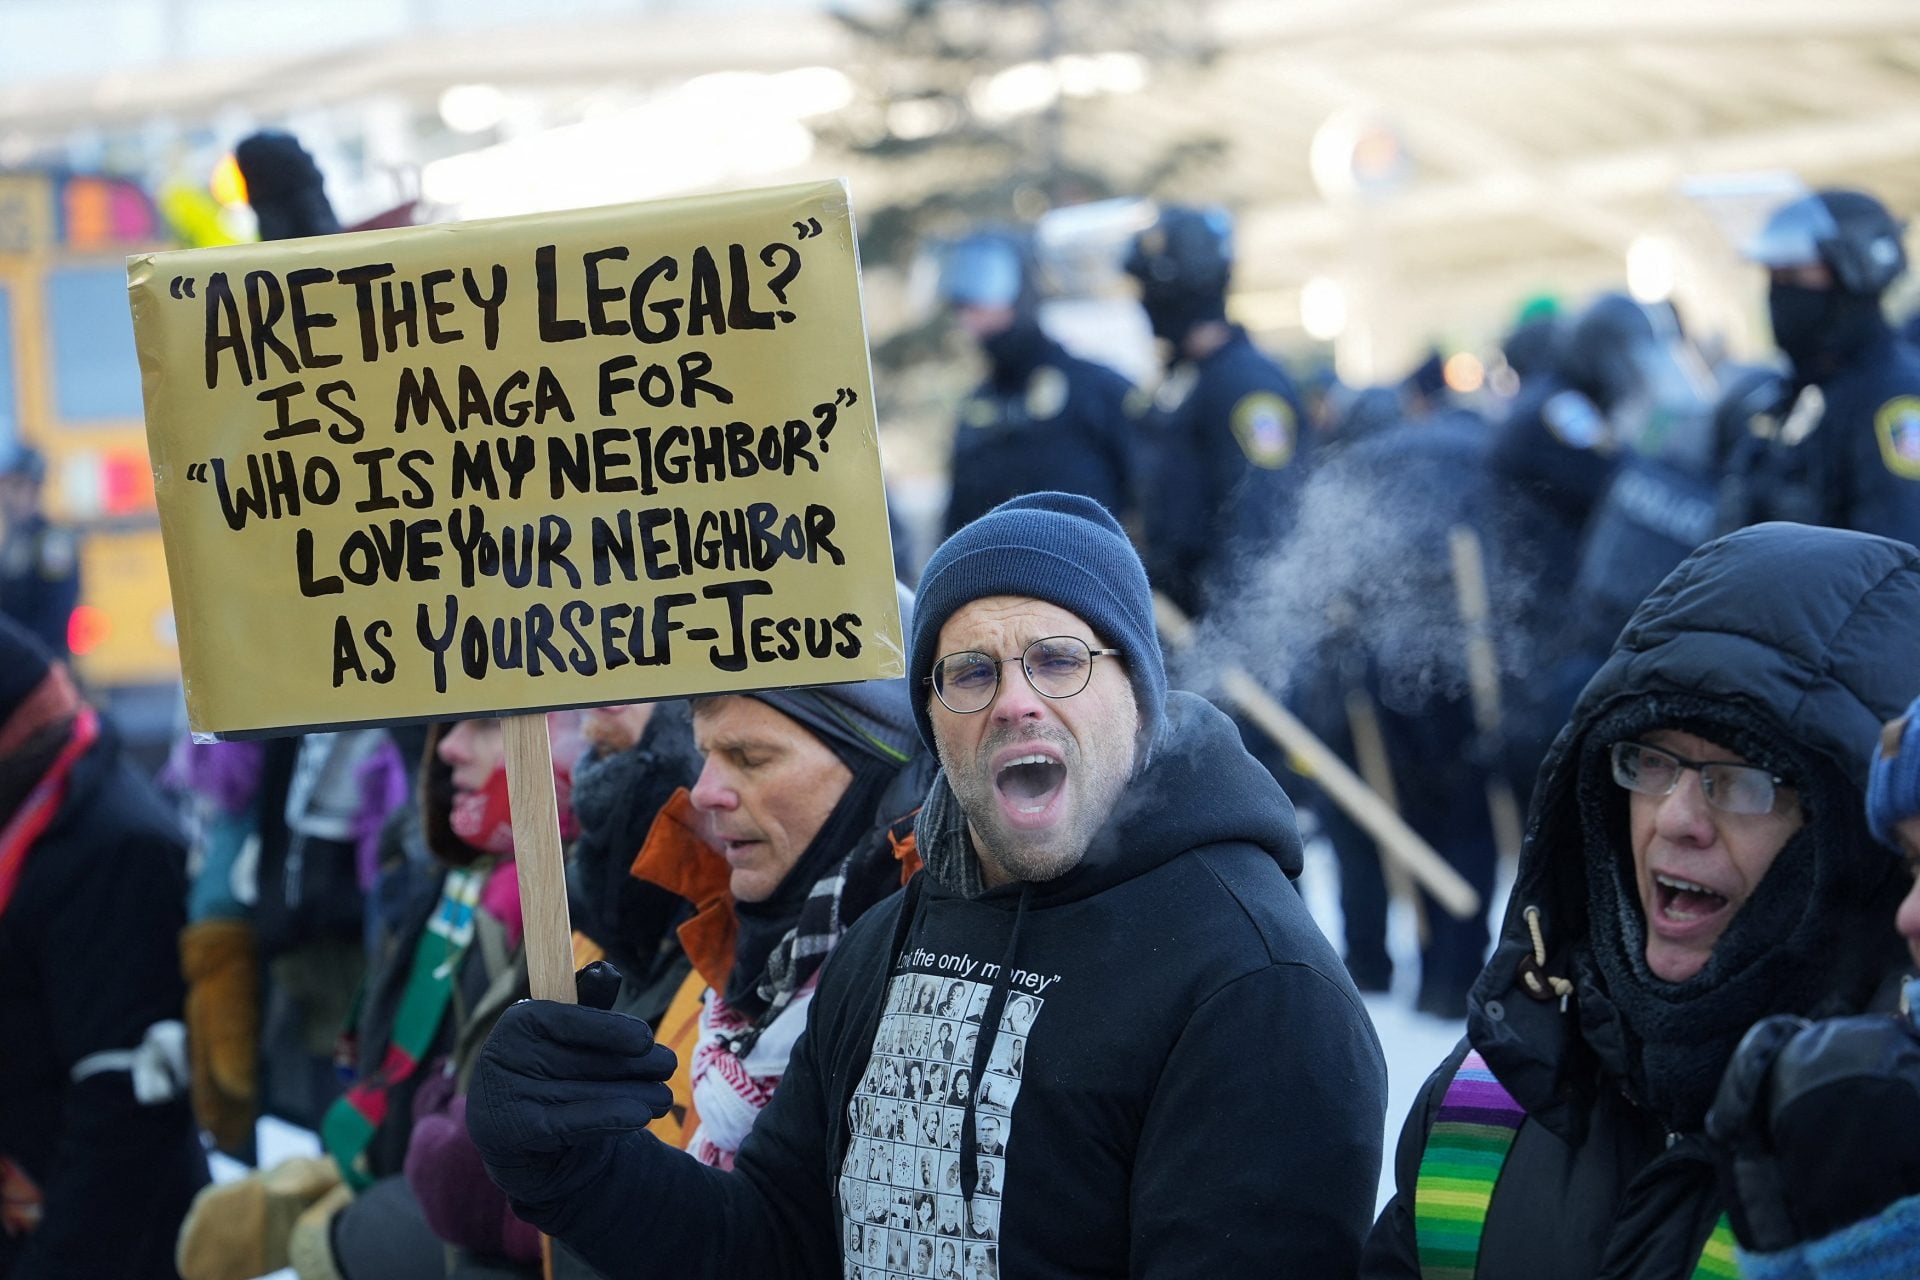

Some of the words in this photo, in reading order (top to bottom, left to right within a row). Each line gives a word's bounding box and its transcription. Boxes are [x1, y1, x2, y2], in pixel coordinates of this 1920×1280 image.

[336, 263, 508, 363] THEY
[257, 380, 366, 445] IS
[395, 365, 576, 434] MAGA
[599, 352, 734, 417] FOR
[353, 447, 435, 514] IS
[452, 435, 537, 500] MY
[296, 519, 444, 598] LOVE
[448, 504, 582, 589] YOUR
[592, 503, 846, 587] NEIGHBOR
[333, 616, 397, 689] AS
[912, 948, 936, 968] the
[938, 953, 979, 978] only
[980, 962, 1062, 994] mney”
